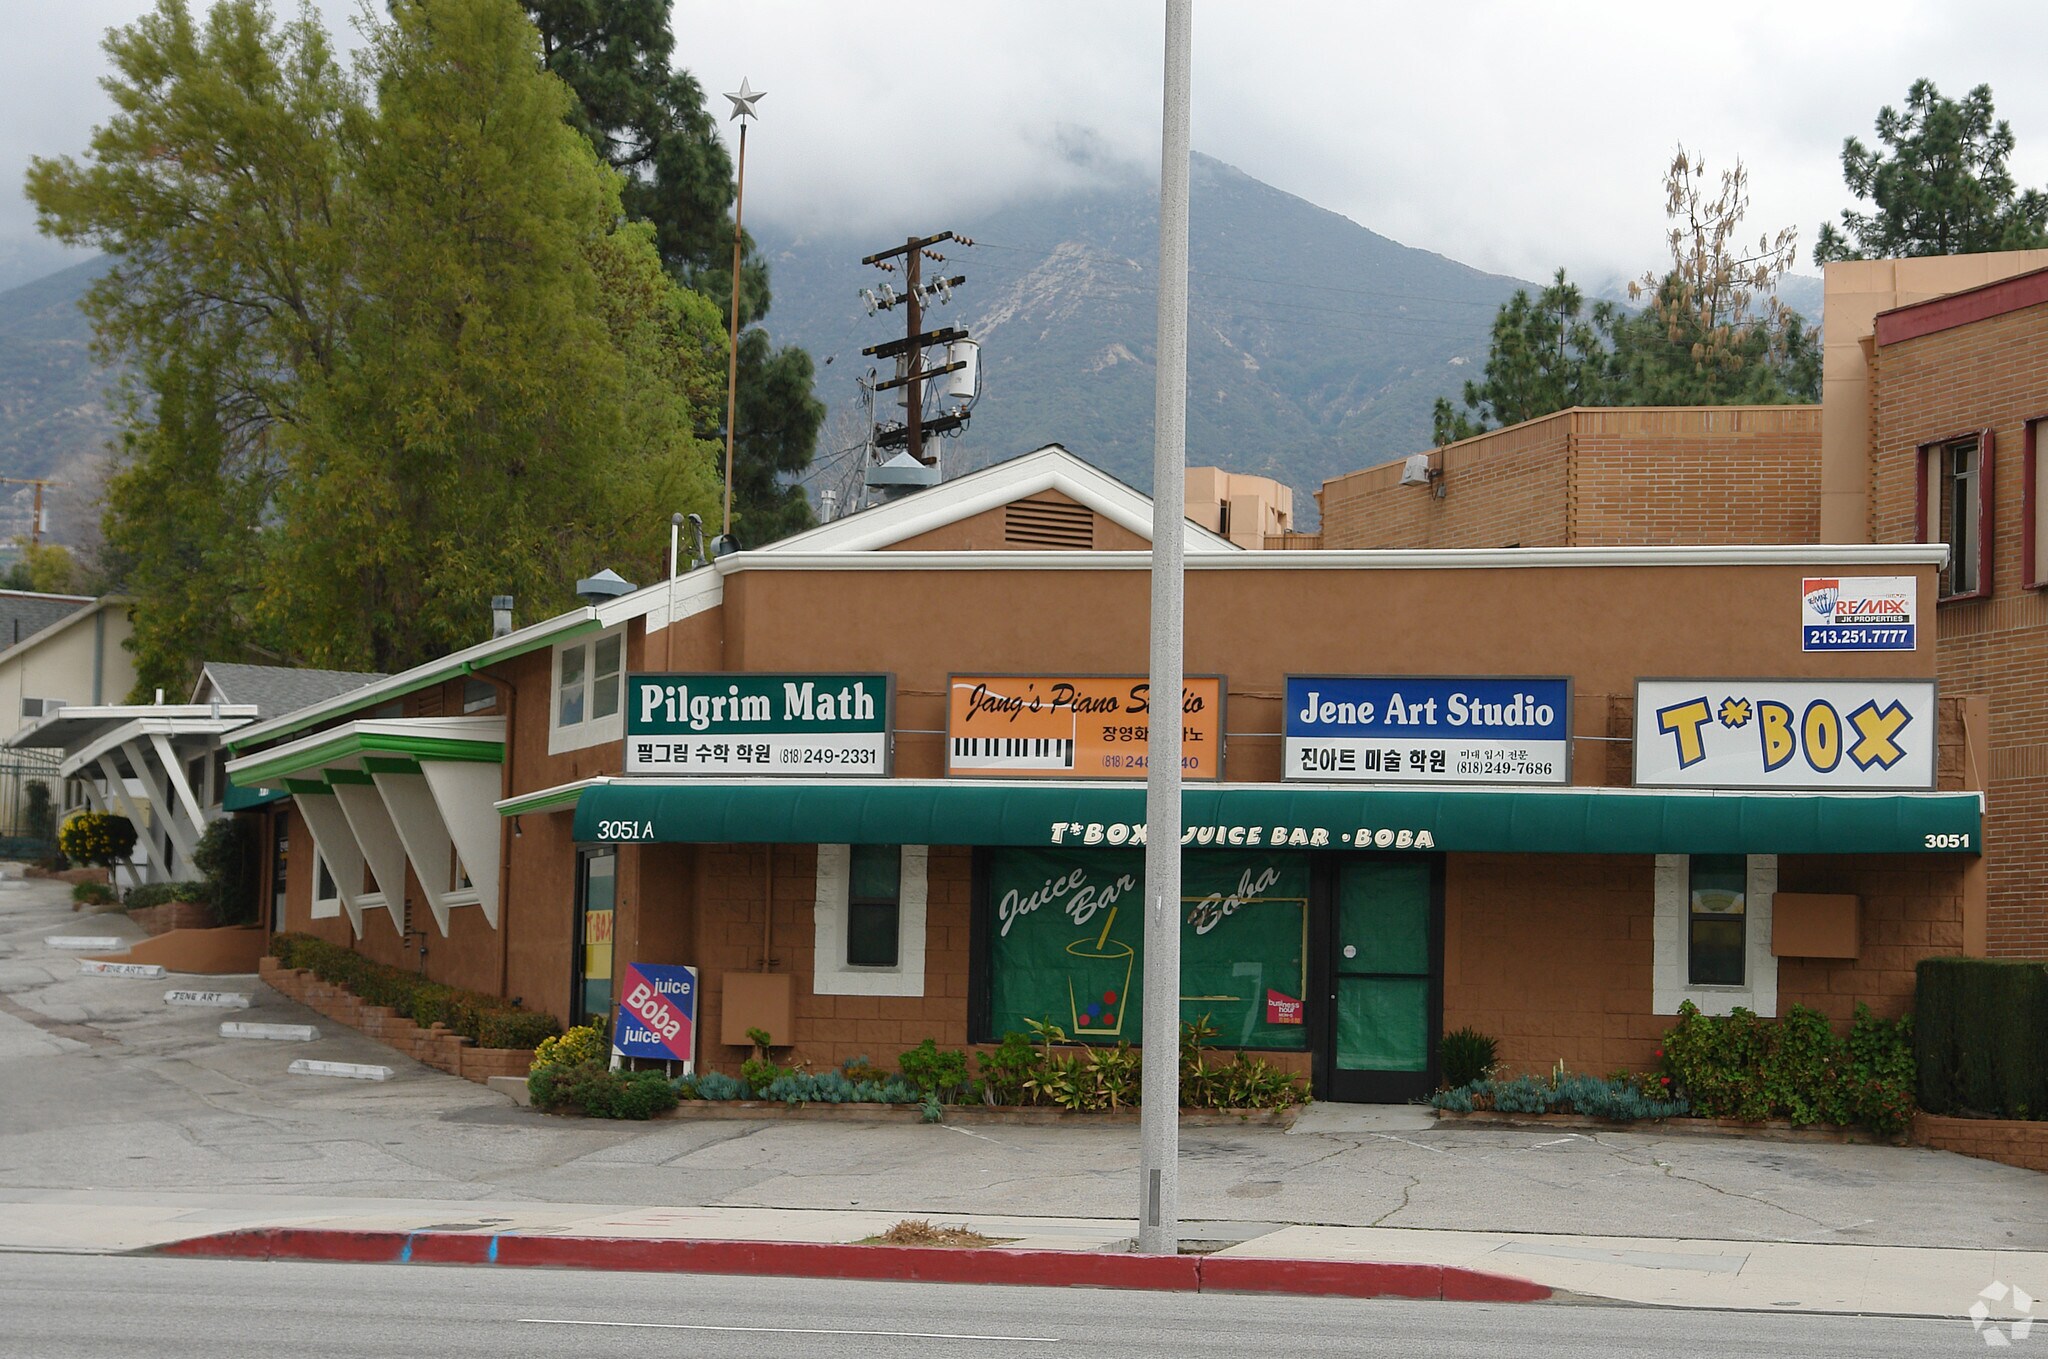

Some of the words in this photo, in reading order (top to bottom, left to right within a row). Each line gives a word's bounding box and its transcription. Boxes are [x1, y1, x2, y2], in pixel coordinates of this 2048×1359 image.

[1811, 630, 1908, 644] 213.251.7777
[640, 684, 771, 730] Pilgrim
[783, 681, 875, 720] Math
[966, 683, 1043, 722] Jang's
[1050, 683, 1119, 714] Piano
[1125, 684, 1205, 713] Sio
[1300, 692, 1374, 724] Jene
[1384, 692, 1437, 724] Art
[1446, 693, 1554, 726] Studio
[637, 744, 688, 763] 필그림
[695, 744, 730, 763] 수학
[736, 744, 771, 763] 학원
[1301, 747, 1356, 771] 진아트
[1365, 748, 1401, 772] 미술
[1409, 750, 1446, 773] 학원
[1180, 826, 1263, 845] JUICE
[1270, 827, 1329, 847] BAR
[1924, 834, 1971, 849] 3051
[999, 868, 1087, 937] Juice
[1065, 874, 1136, 926] Bar
[172, 991, 198, 1001] JENE
[201, 991, 222, 1002] ART
[653, 978, 691, 997] juice
[626, 983, 681, 1040] Boba
[1268, 999, 1300, 1008] business
[623, 1026, 661, 1045] juice
